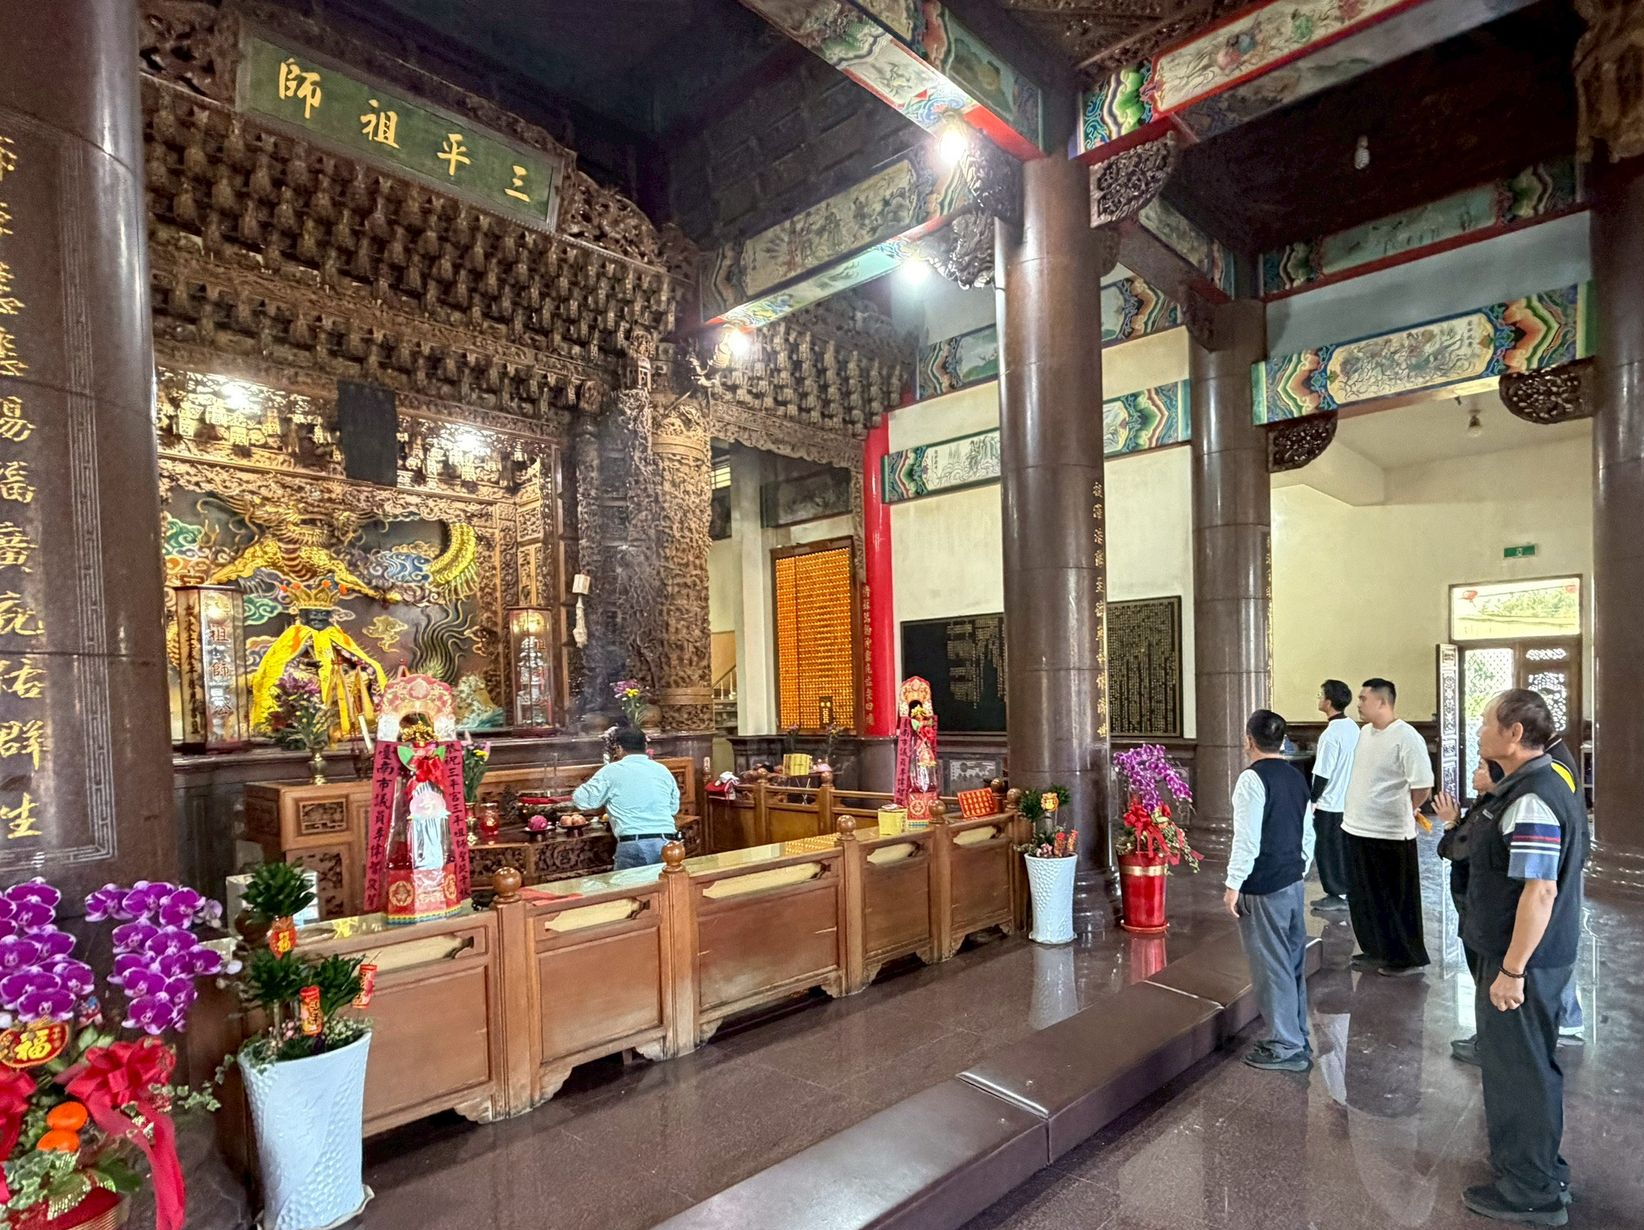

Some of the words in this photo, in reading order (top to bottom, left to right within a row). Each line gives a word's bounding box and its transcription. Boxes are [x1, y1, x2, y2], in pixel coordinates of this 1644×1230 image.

[278, 57, 531, 202] 三平祖師
[15, 1029, 52, 1061] 福
